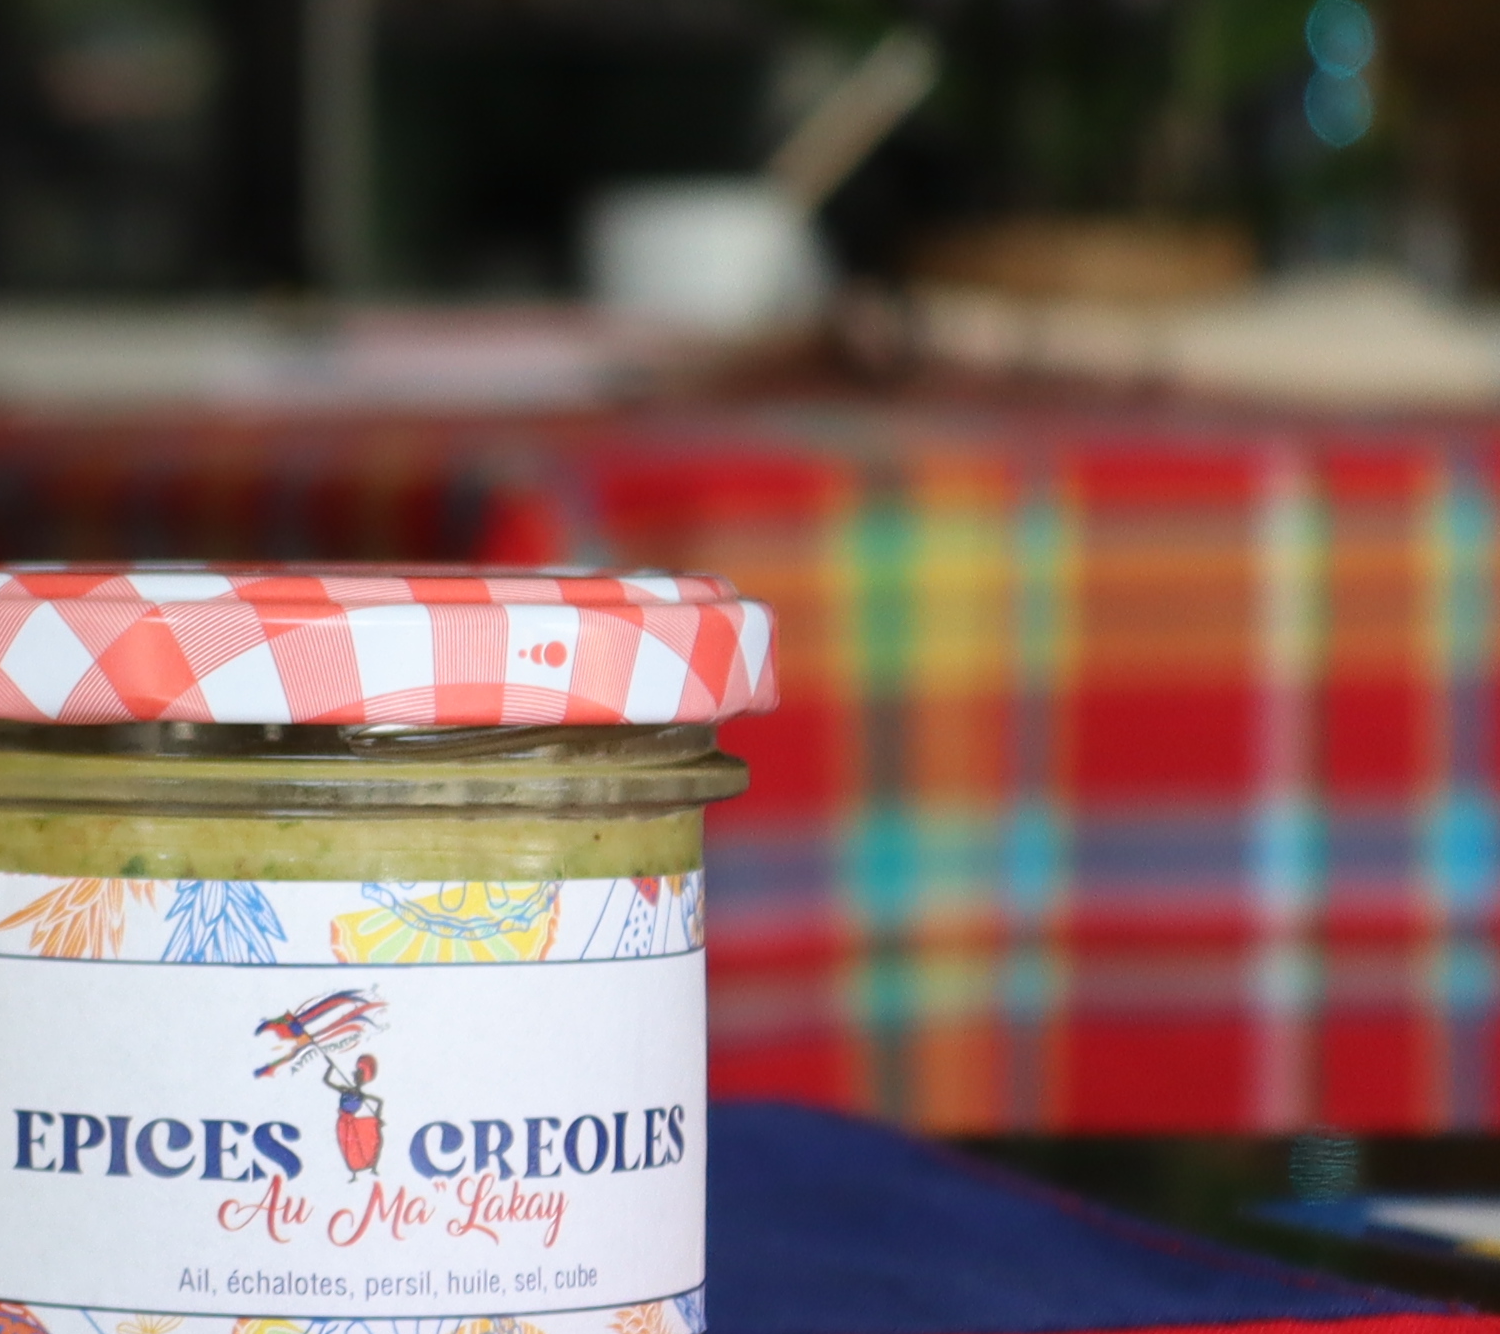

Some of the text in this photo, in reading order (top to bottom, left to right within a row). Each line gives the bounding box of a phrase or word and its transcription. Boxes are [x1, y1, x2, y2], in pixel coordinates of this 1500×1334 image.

[13, 1104, 686, 1183] EPICES CREOLES
[217, 1173, 315, 1244] Au
[446, 1172, 571, 1250] Lakay
[178, 1263, 599, 1302] Ail, échalotes, persil, huile, sel, cube
